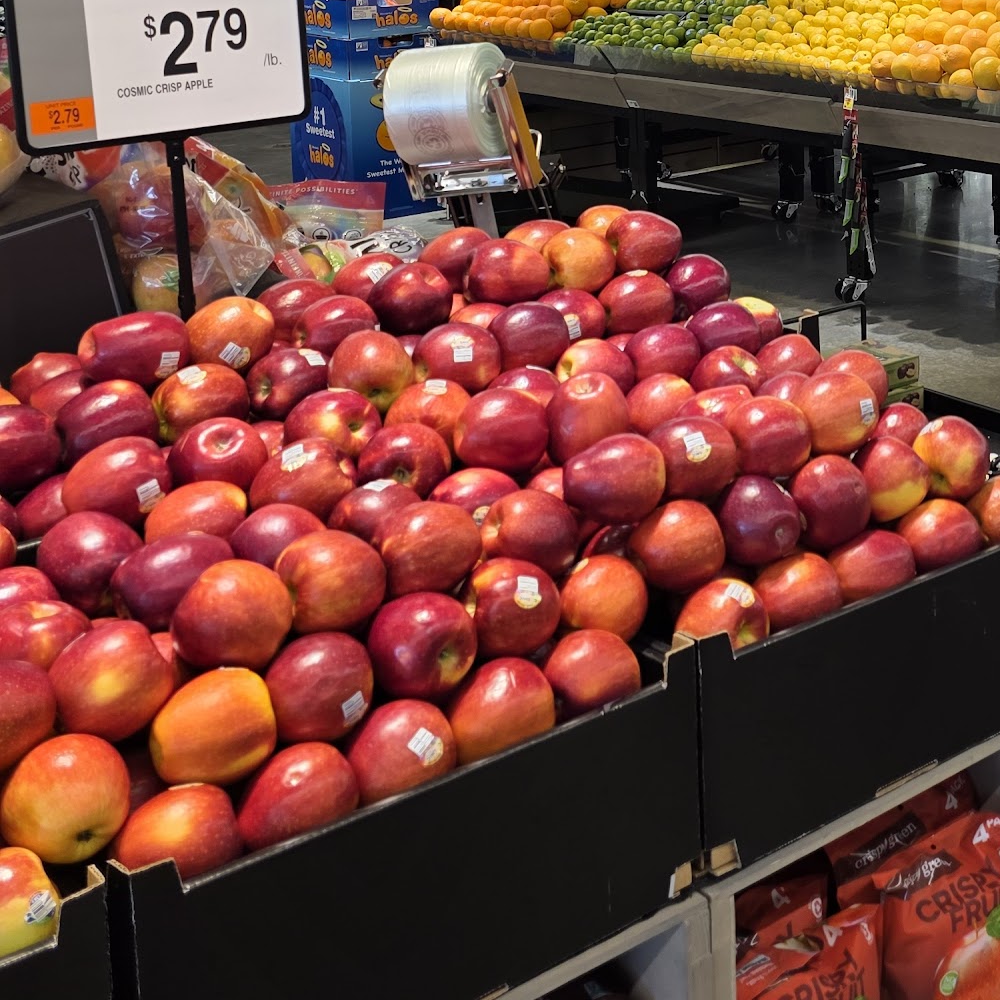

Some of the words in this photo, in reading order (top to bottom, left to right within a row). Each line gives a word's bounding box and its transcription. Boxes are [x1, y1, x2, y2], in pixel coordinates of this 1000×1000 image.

[375, 9, 419, 28] halos
[263, 53, 283, 67] /lb.
[308, 42, 332, 68] alos
[117, 85, 153, 98] COSMIC
[155, 82, 182, 94] CRISP
[185, 78, 214, 91] APPLE
[49, 107, 80, 125] $2.79
[313, 106, 326, 126] #1
[306, 123, 336, 139] Sweetest
[309, 144, 335, 168] halos
[380, 159, 392, 167] The
[366, 167, 396, 179] Sweetest
[972, 822, 990, 845] 4
